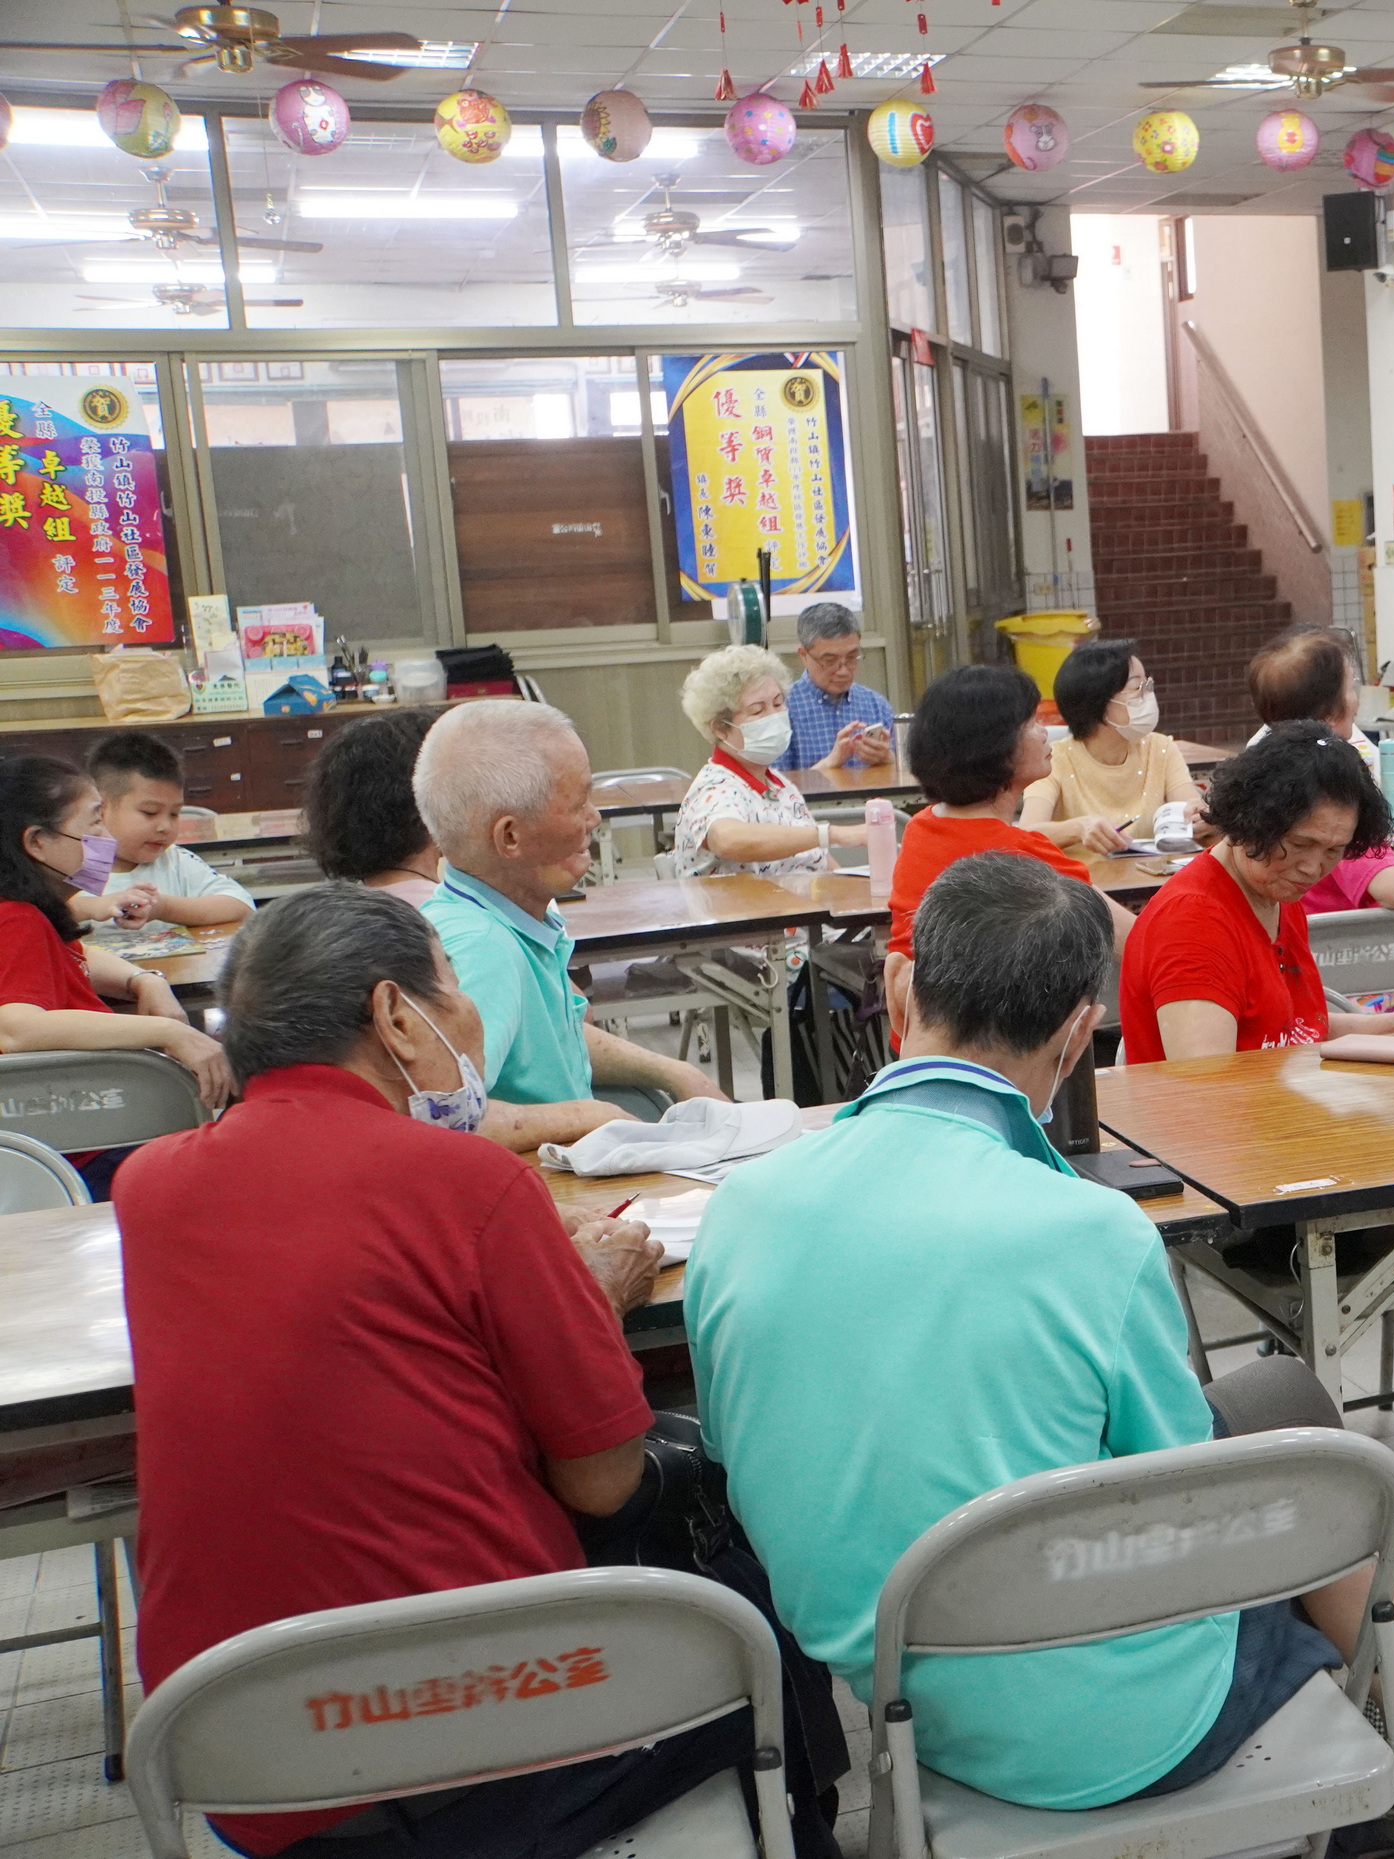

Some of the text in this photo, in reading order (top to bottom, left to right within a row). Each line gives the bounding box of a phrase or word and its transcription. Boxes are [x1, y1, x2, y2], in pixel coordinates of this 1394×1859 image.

[39, 449, 77, 542] 卓越組
[712, 388, 747, 506] 優等獎
[52, 553, 79, 594] 評定
[80, 436, 124, 634] 榮獲南投縣政府一一三年度
[110, 437, 152, 633] 竹山鎮竹山社區發展協會
